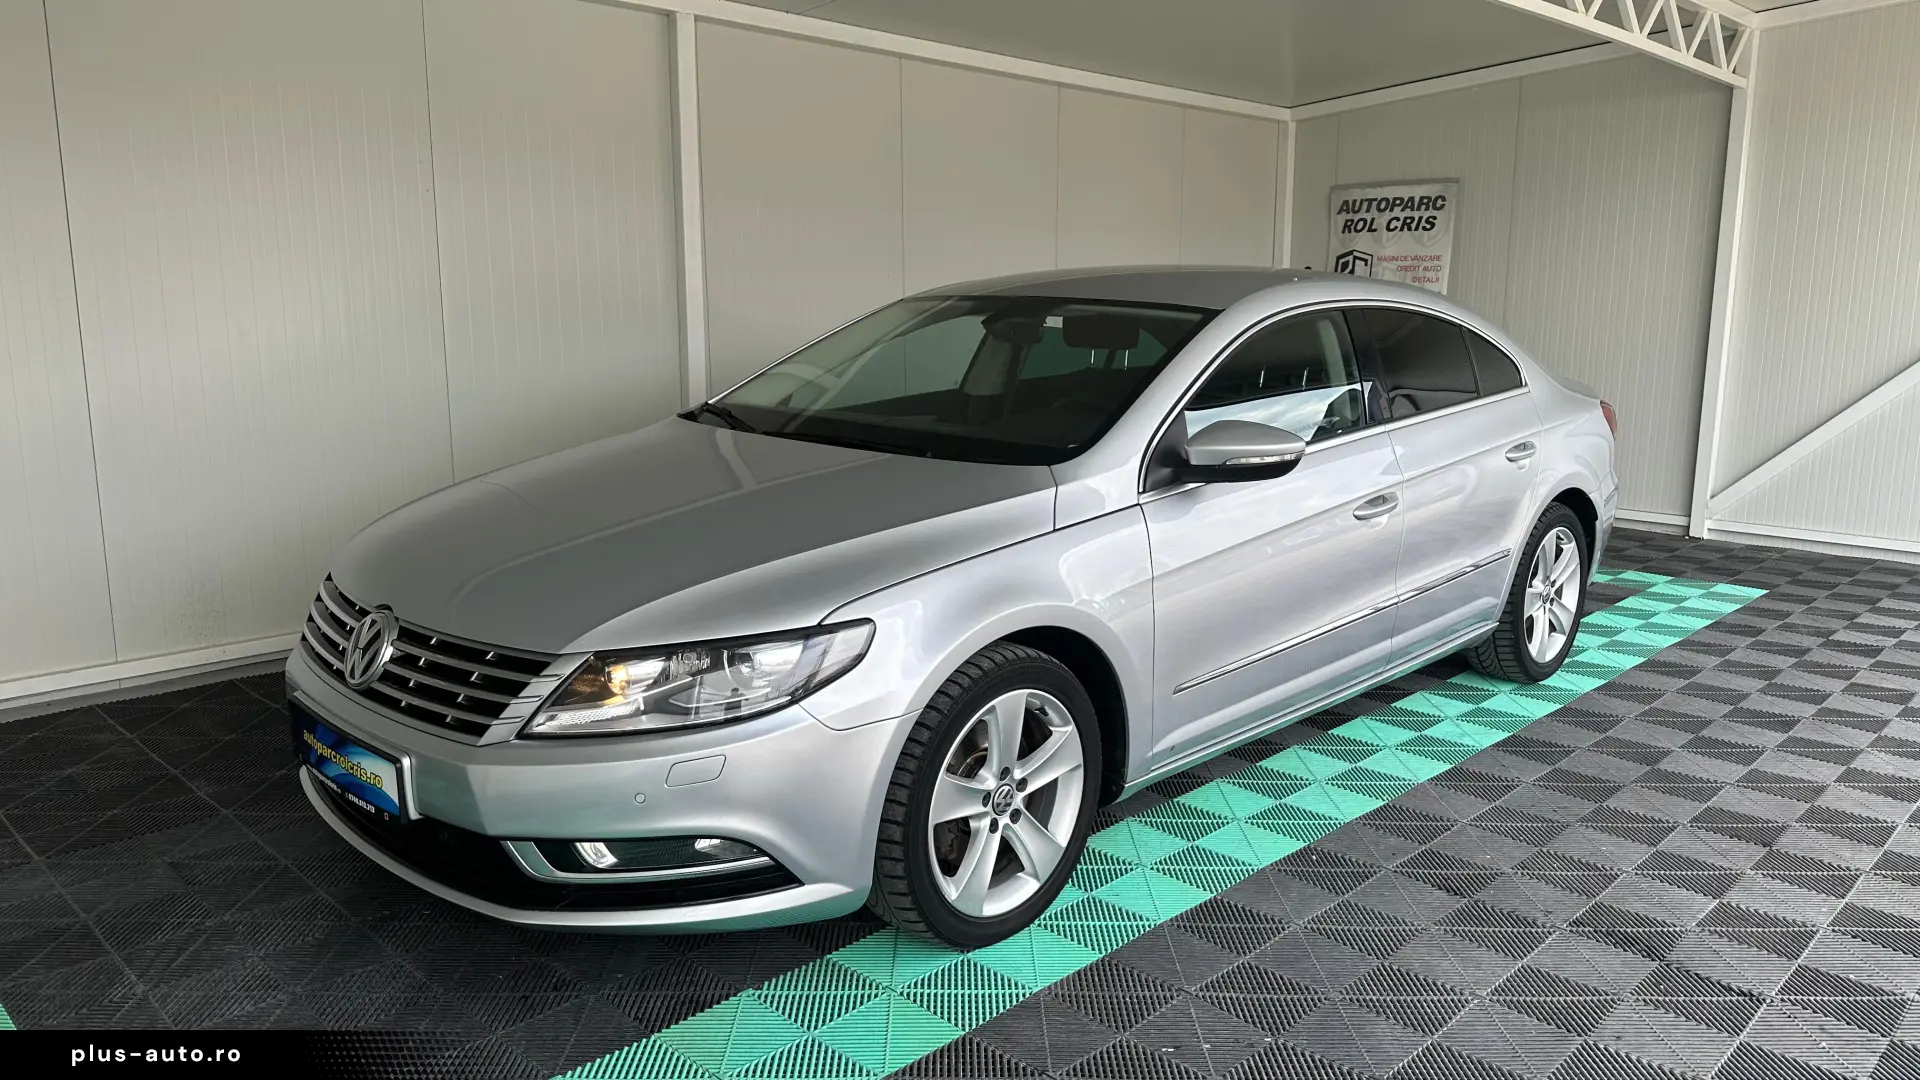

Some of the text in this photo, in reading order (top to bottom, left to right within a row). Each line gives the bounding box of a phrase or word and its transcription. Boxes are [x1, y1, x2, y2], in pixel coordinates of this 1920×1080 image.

[1336, 194, 1447, 216] AUTOPARC
[1341, 215, 1438, 234] ROL CRIS
[1396, 265, 1442, 273] CREDIT AUTO
[1412, 276, 1440, 284] DETALII
[303, 729, 383, 790] autoparcrolcris.ro
